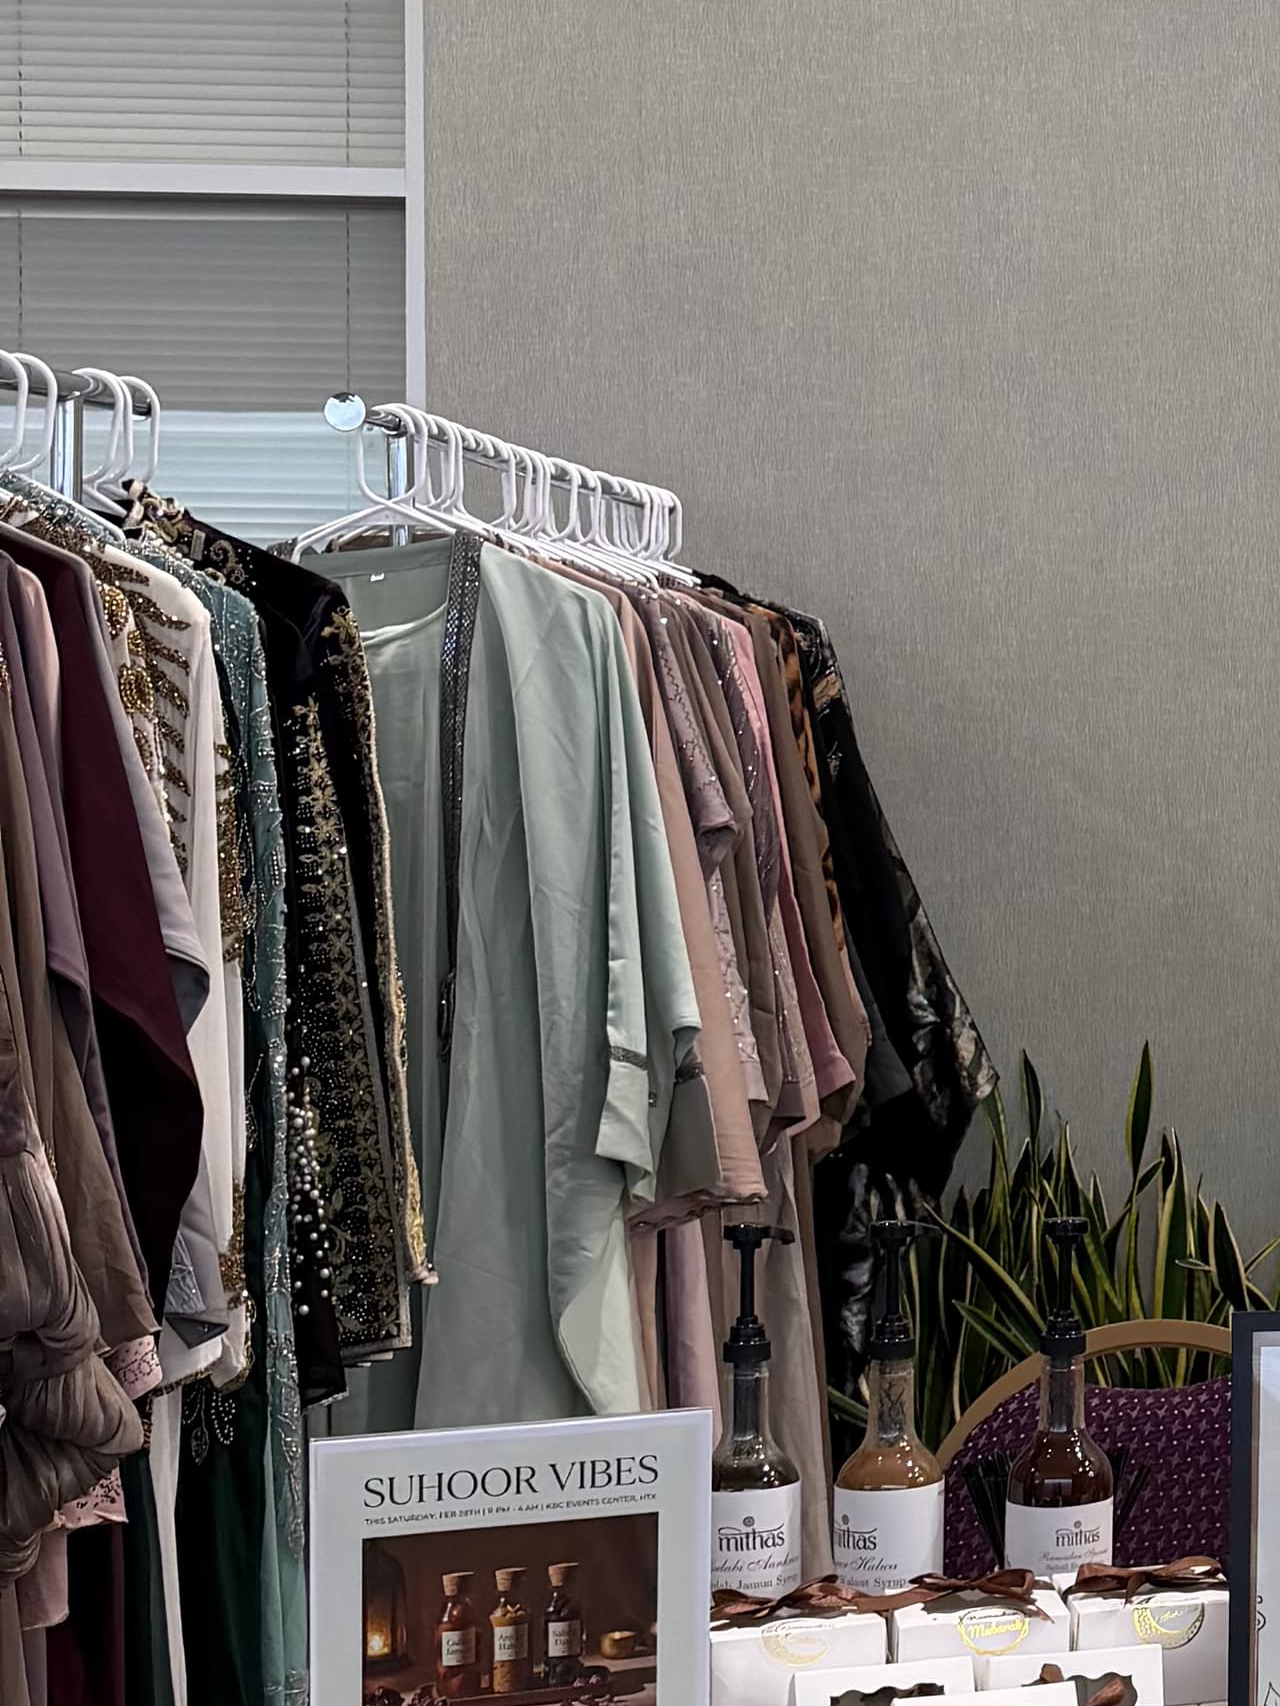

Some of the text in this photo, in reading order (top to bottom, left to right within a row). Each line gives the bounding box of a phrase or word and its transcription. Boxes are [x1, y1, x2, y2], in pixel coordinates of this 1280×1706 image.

[362, 1454, 660, 1509] SUHOOR VIBES
[566, 1498, 601, 1509] EVENTS
[717, 1522, 786, 1553] mithas
